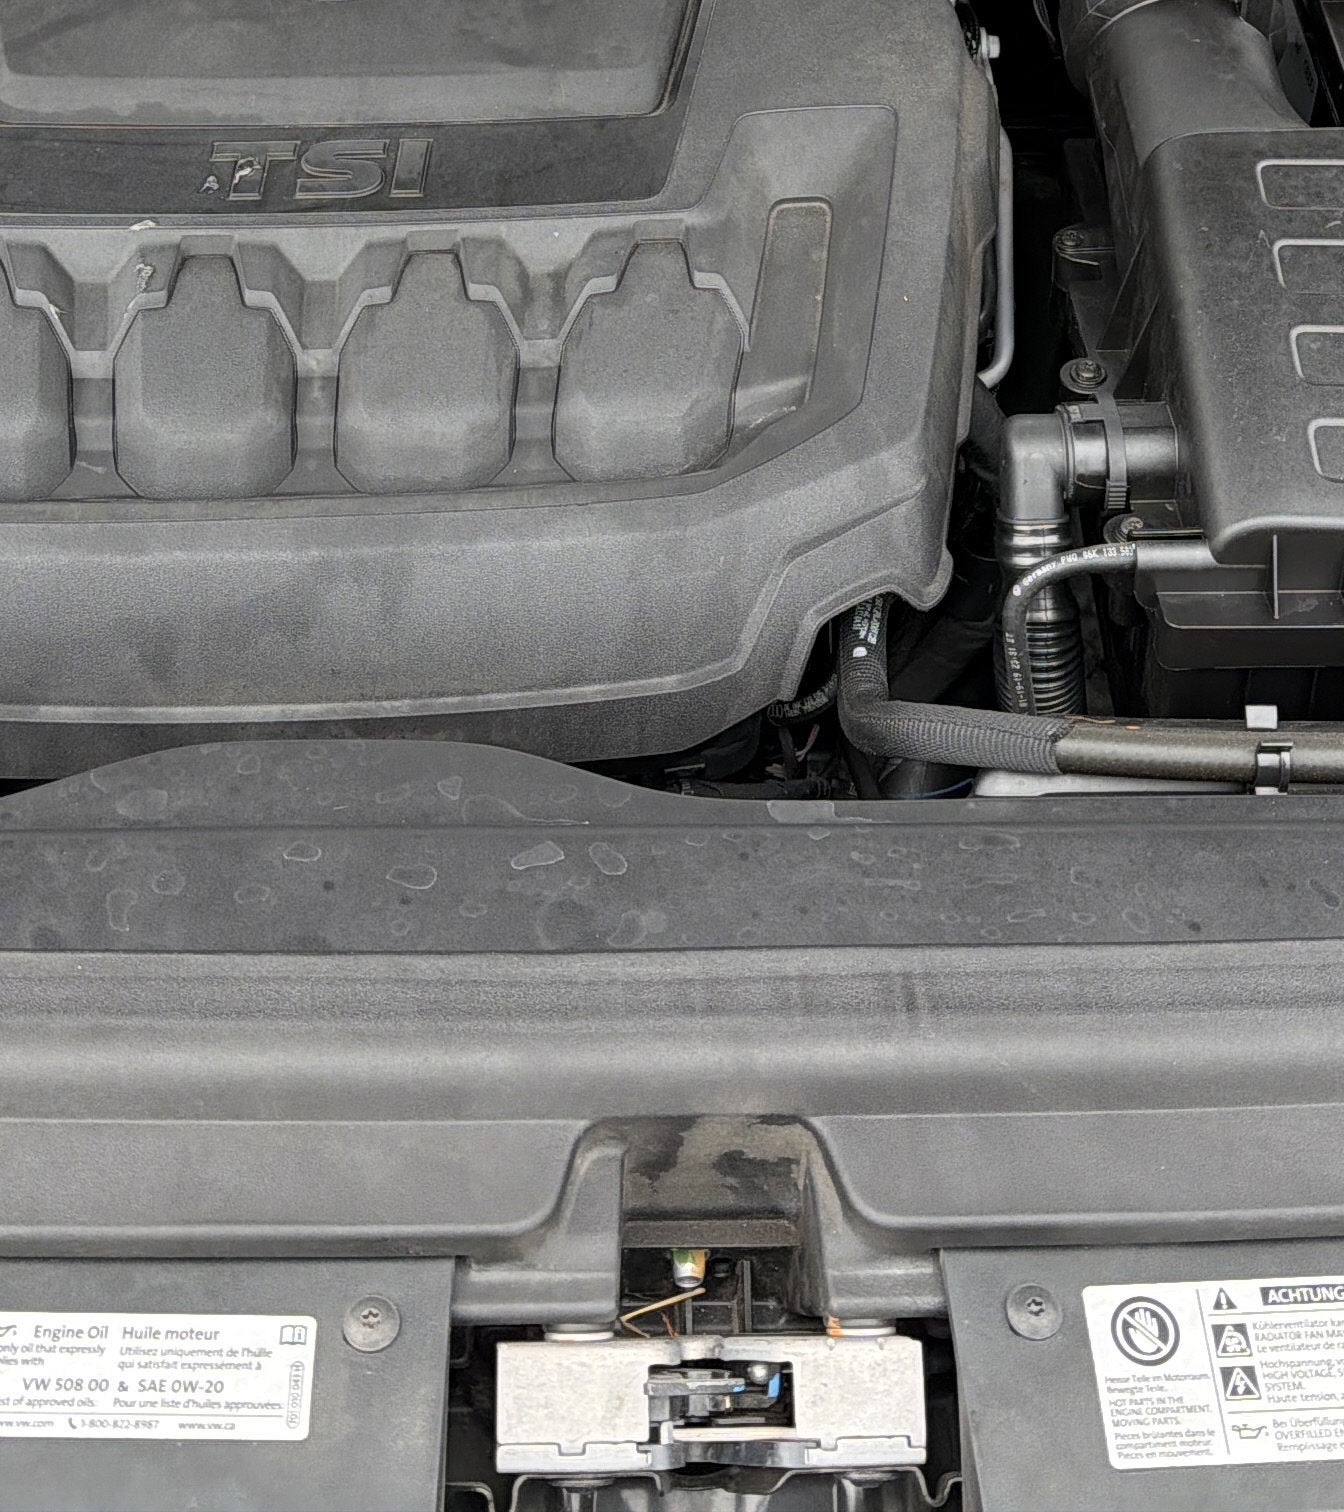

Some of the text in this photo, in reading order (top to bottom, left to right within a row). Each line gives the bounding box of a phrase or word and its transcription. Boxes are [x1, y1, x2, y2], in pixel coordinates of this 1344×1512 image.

[209, 138, 435, 201] TSI
[32, 1324, 109, 1342] Engine Oil
[121, 1325, 220, 1341] Huile moteur
[20, 1343, 34, 1353] oil
[35, 1343, 57, 1353] that
[225, 1347, 239, 1358] de
[20, 1356, 45, 1366] with
[20, 1376, 225, 1394] VW 508 00 & SAE 0W-20
[12, 1395, 24, 1406] of
